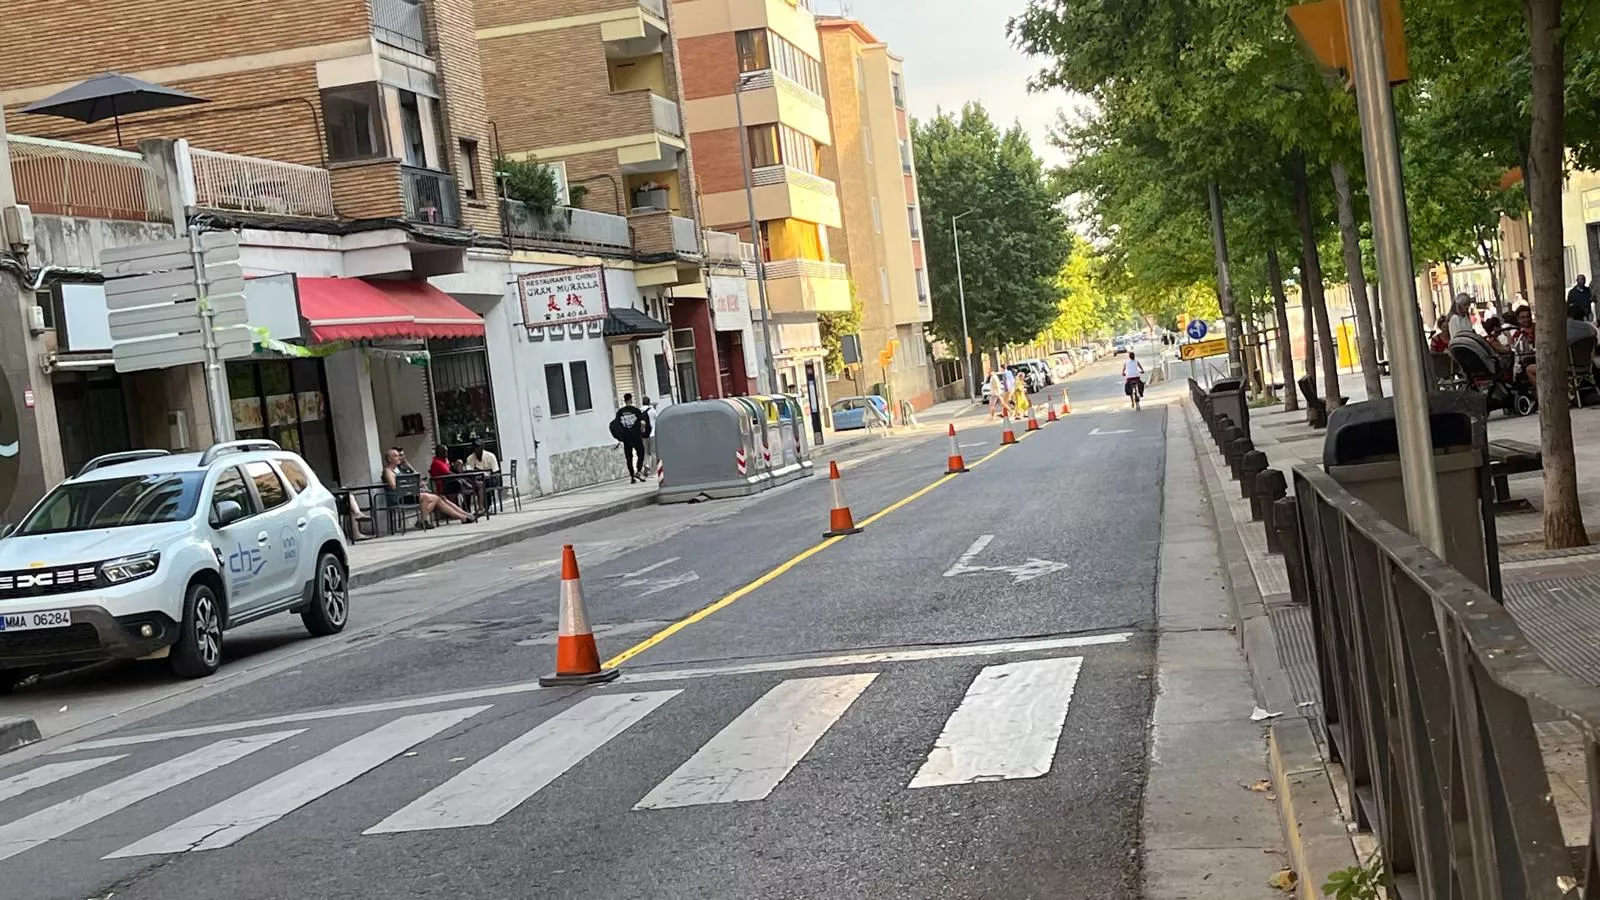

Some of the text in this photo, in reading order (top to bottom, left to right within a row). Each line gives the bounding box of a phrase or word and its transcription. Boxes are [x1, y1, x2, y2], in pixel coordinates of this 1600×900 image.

[526, 276, 572, 286] RESTAURANTE
[527, 282, 599, 297] GRAN MURALLA
[33, 612, 69, 626] 06284
